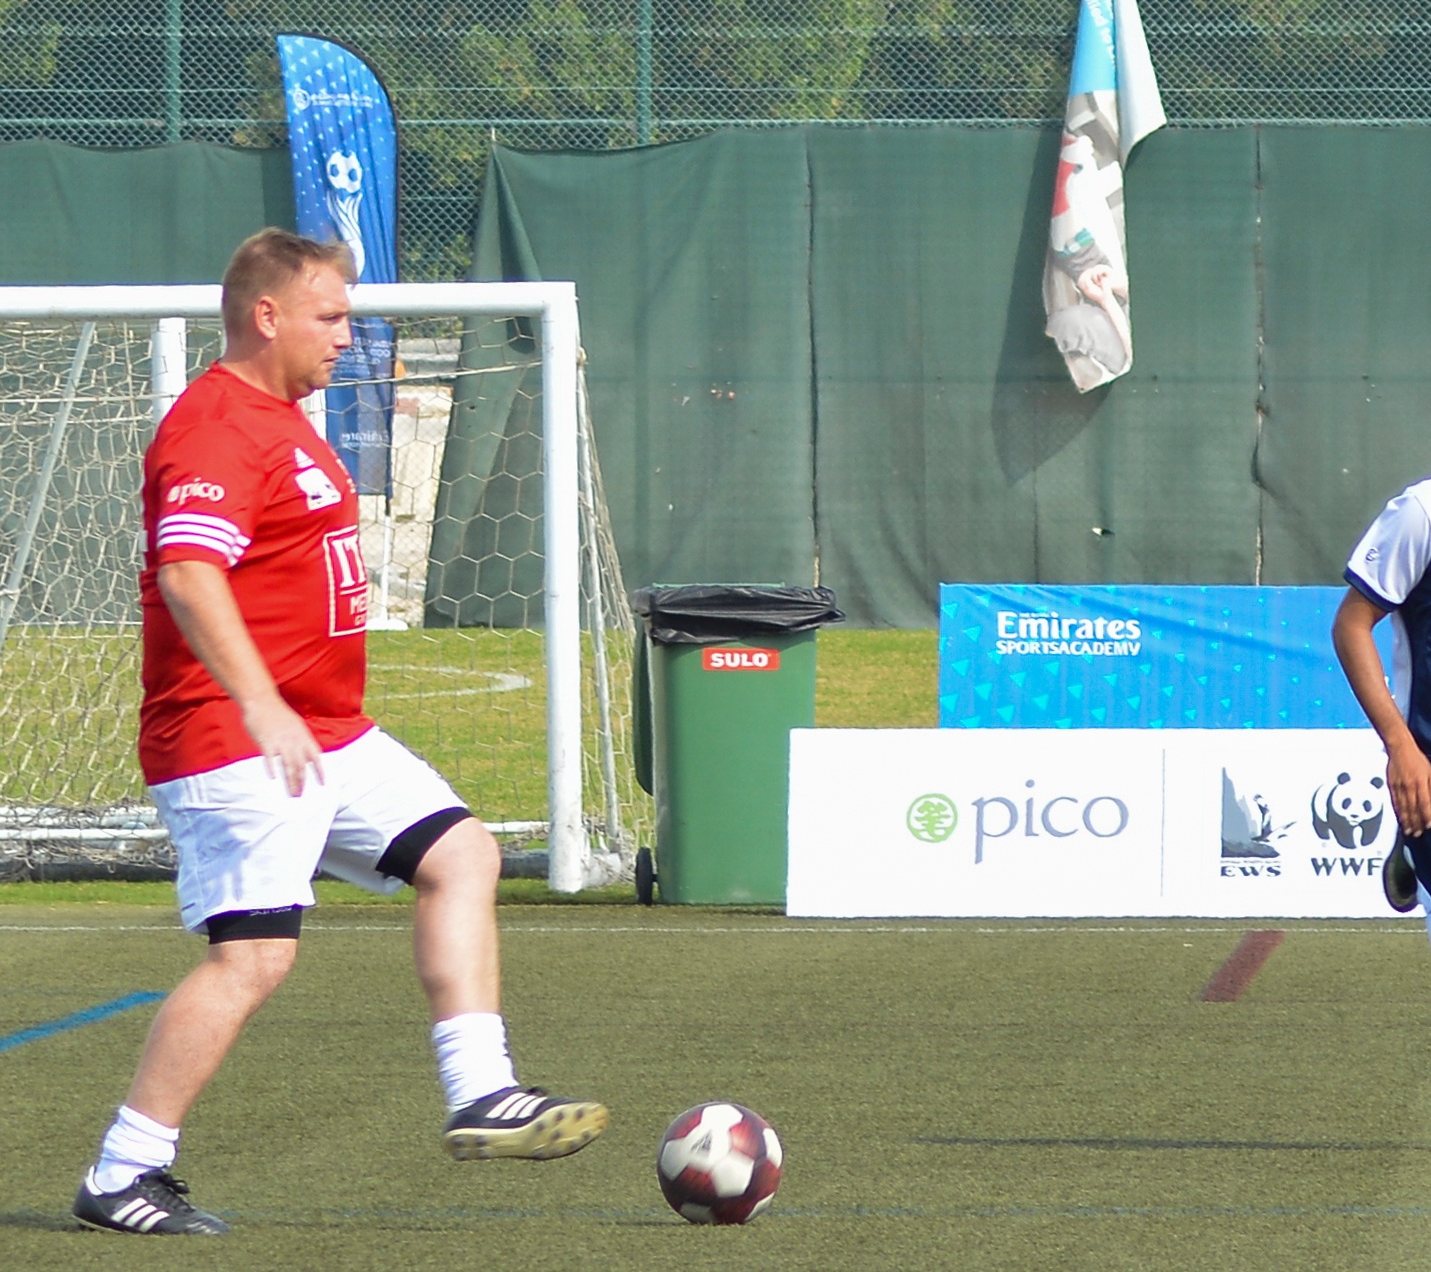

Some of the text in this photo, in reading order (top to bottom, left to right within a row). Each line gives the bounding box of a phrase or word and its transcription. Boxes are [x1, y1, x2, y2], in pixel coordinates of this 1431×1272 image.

[178, 477, 225, 505] pico
[331, 534, 366, 588] IT
[997, 611, 1142, 639] Emirates
[710, 652, 769, 668] SULO
[971, 779, 1130, 864] pico
[1220, 865, 1282, 877] EWS
[1311, 857, 1384, 876] WWF
